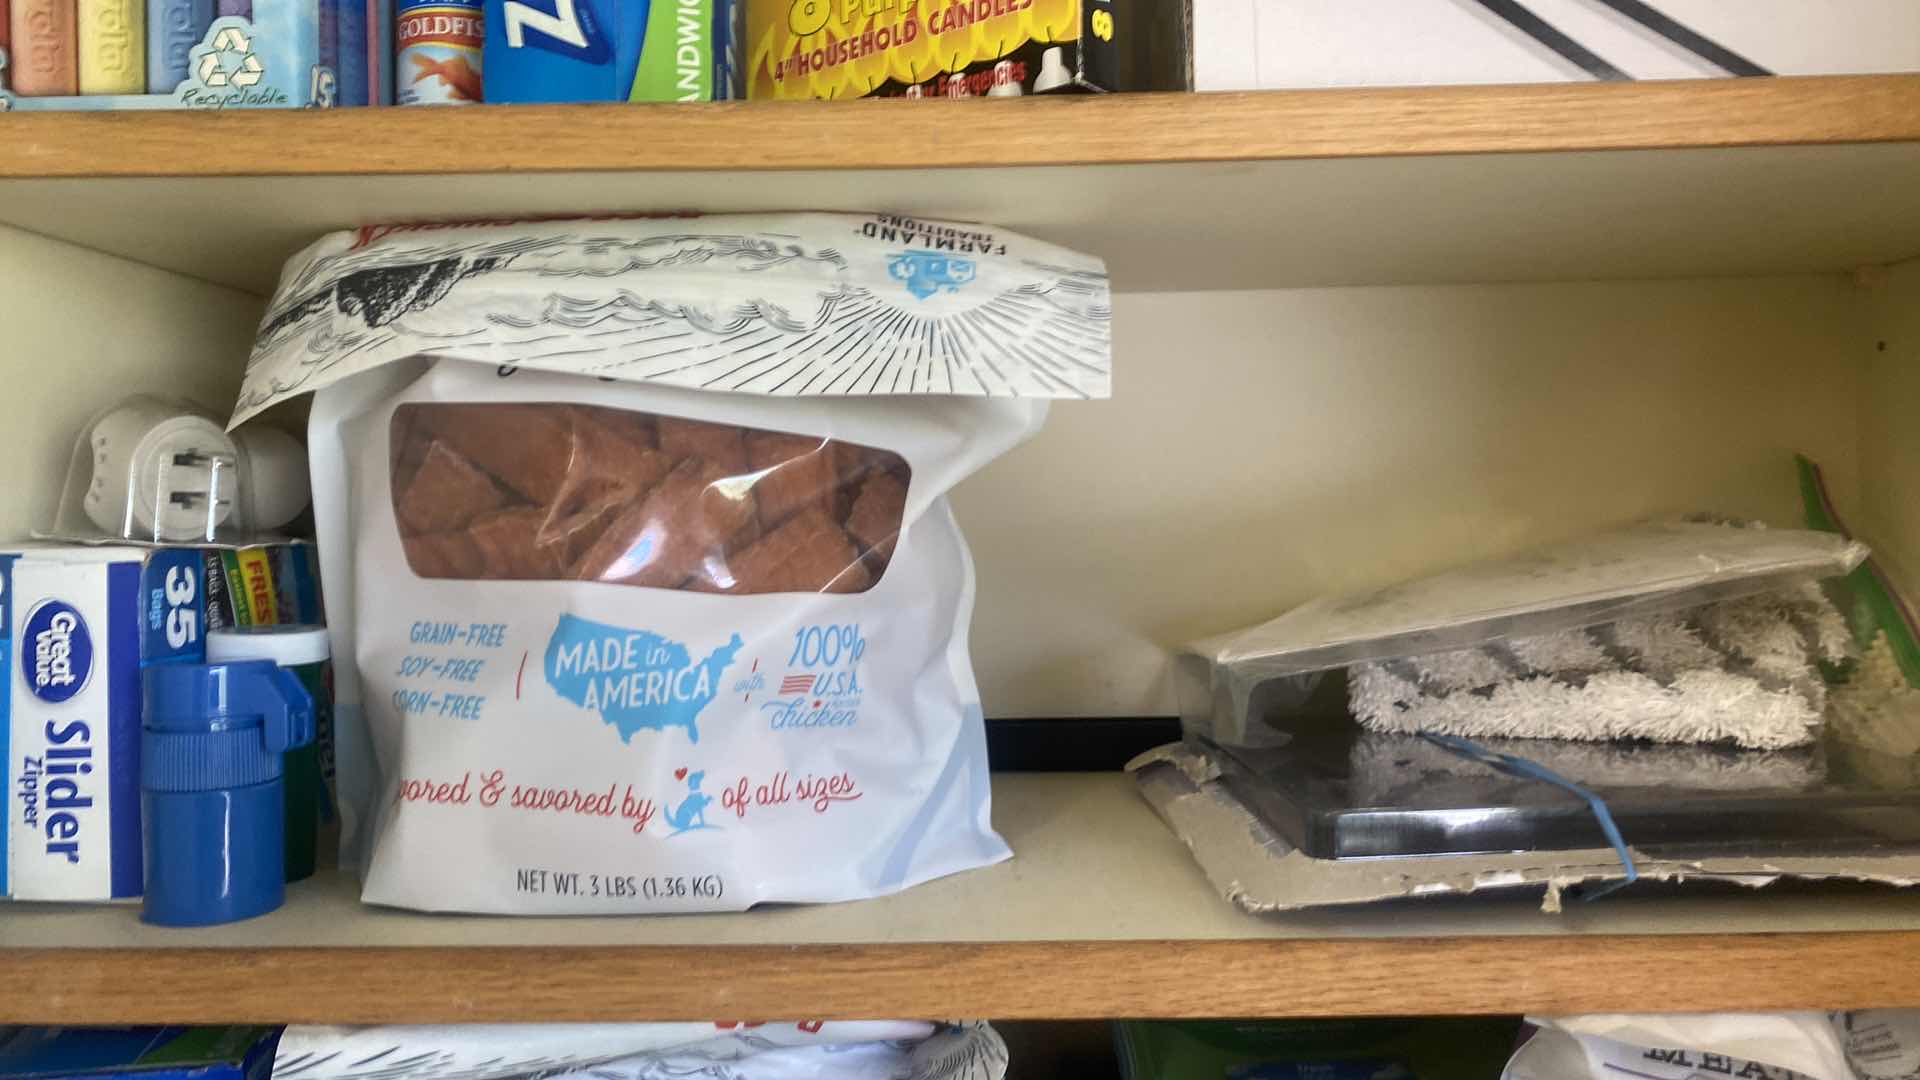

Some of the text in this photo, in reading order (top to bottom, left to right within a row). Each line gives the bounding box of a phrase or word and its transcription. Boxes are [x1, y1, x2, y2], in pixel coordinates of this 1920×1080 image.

[797, 18, 918, 77] HOUSEHOLD
[178, 88, 289, 110] Recyclable
[860, 221, 1007, 256] FARMLAND
[165, 565, 196, 650] 35
[50, 611, 77, 687] Great
[410, 621, 508, 648] GRAIN-FREE
[554, 633, 671, 679] MADE in
[787, 623, 865, 668] 100%
[36, 629, 52, 688] Value
[395, 656, 486, 682] SOY-FREE
[583, 663, 711, 711] AMERICA
[735, 673, 764, 694] with
[813, 671, 863, 697] U.S.A.
[760, 697, 857, 729] chicken
[17, 755, 43, 829] Zipper
[44, 719, 94, 864] Slider
[479, 768, 506, 808] &
[510, 783, 617, 817] savored
[620, 783, 656, 834] by
[720, 776, 751, 818] of
[755, 771, 791, 806] all
[796, 772, 864, 813] sizes
[516, 867, 724, 901] NET WT. 3 LBS (1.36 KG)
